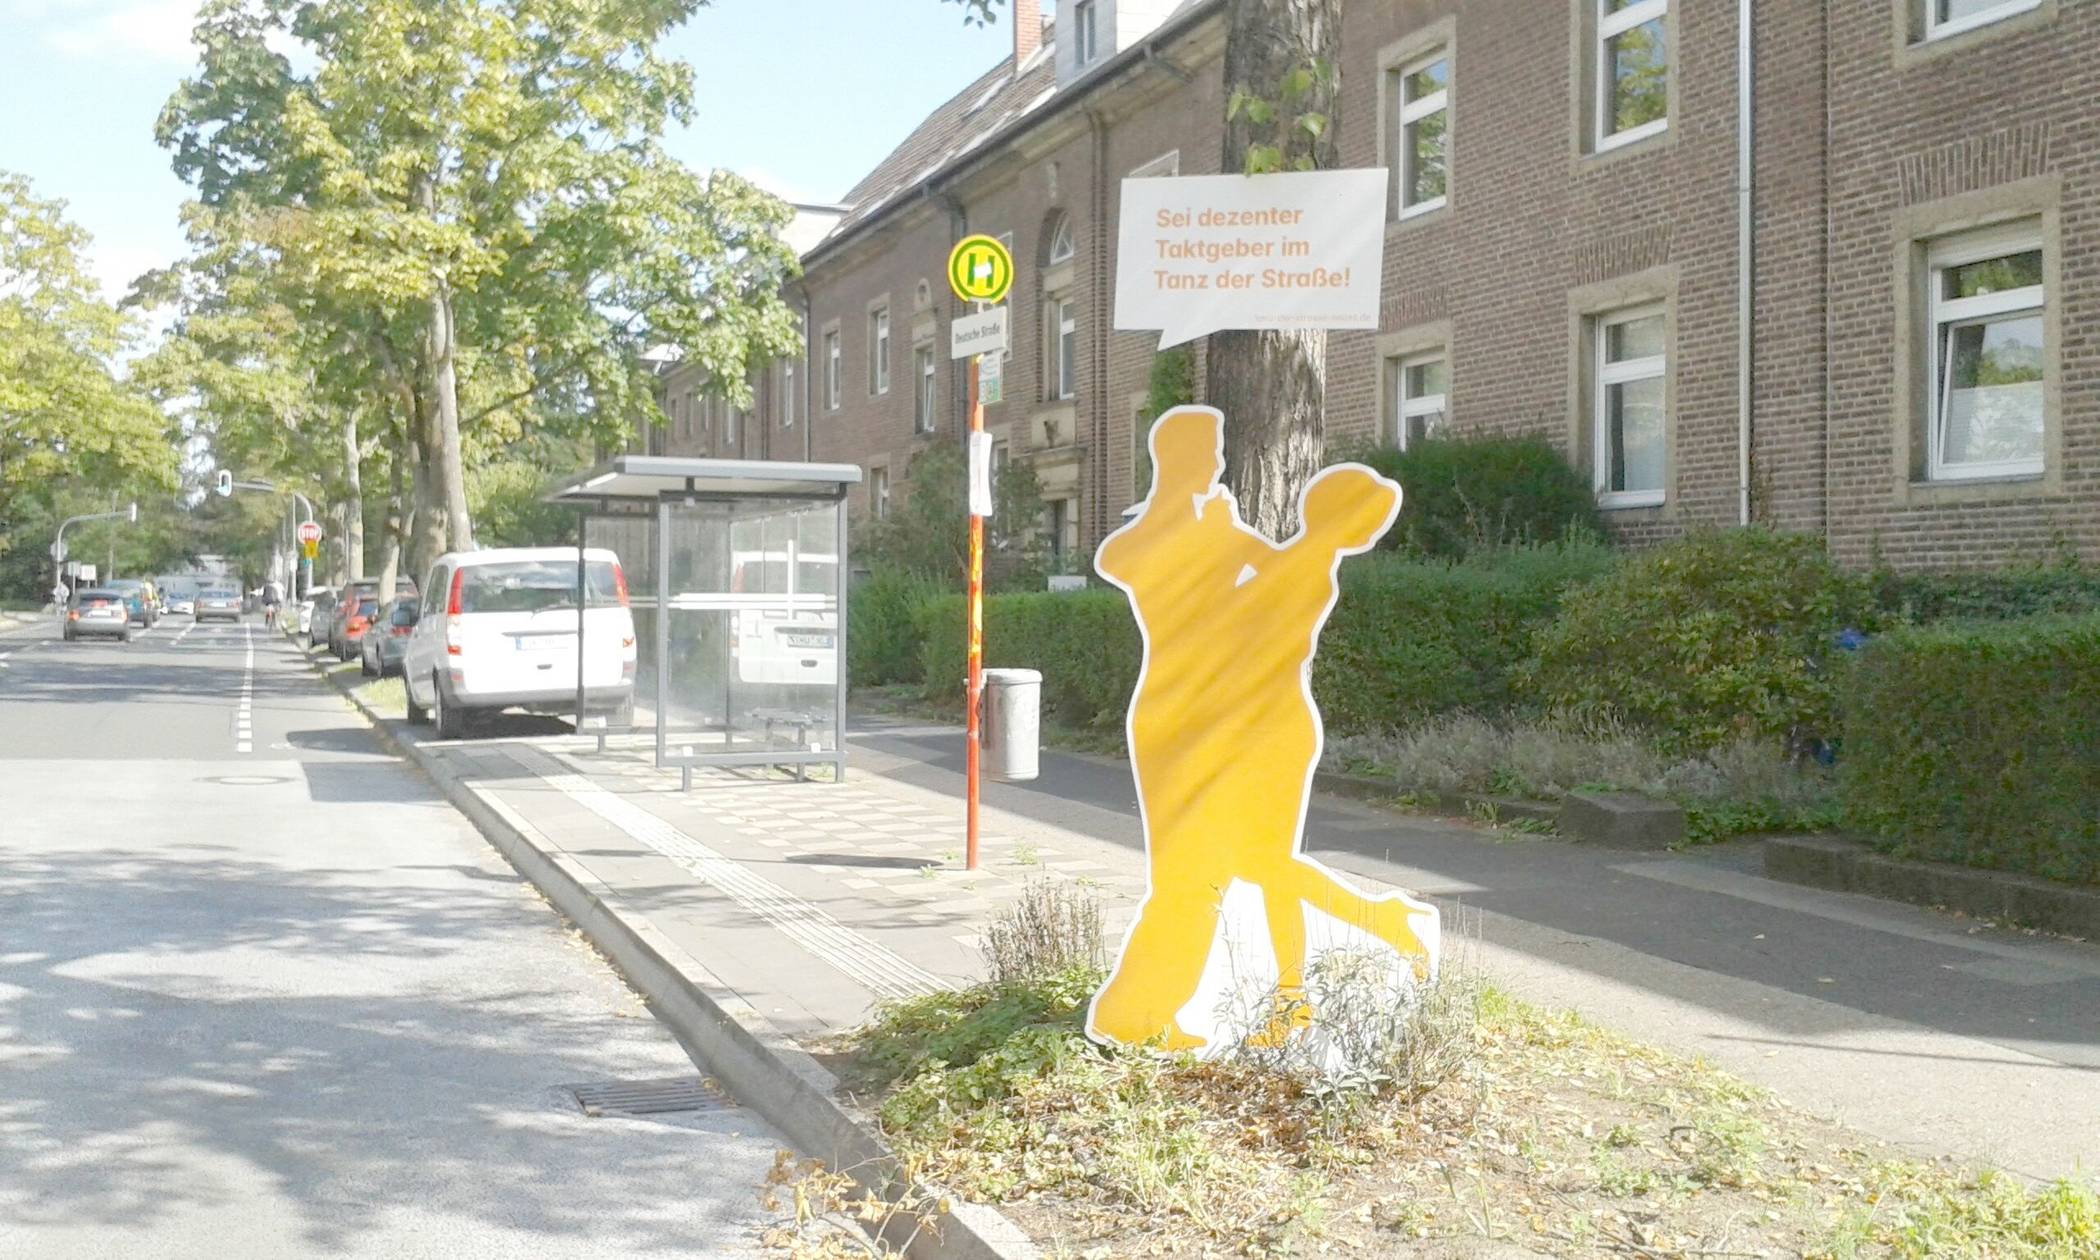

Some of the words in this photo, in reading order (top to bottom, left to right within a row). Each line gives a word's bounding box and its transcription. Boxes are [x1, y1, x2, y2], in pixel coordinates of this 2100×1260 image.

[1156, 208, 1191, 228] Sei
[1198, 207, 1303, 227] dezenter
[1155, 239, 1274, 262] Taktgeber
[1281, 235, 1310, 256] im
[967, 252, 995, 289] H
[1154, 270, 1209, 290] Tanz
[1216, 269, 1254, 289] der
[1261, 266, 1351, 289] Straße!
[981, 322, 1000, 337] Straße
[300, 528, 321, 539] STOP
